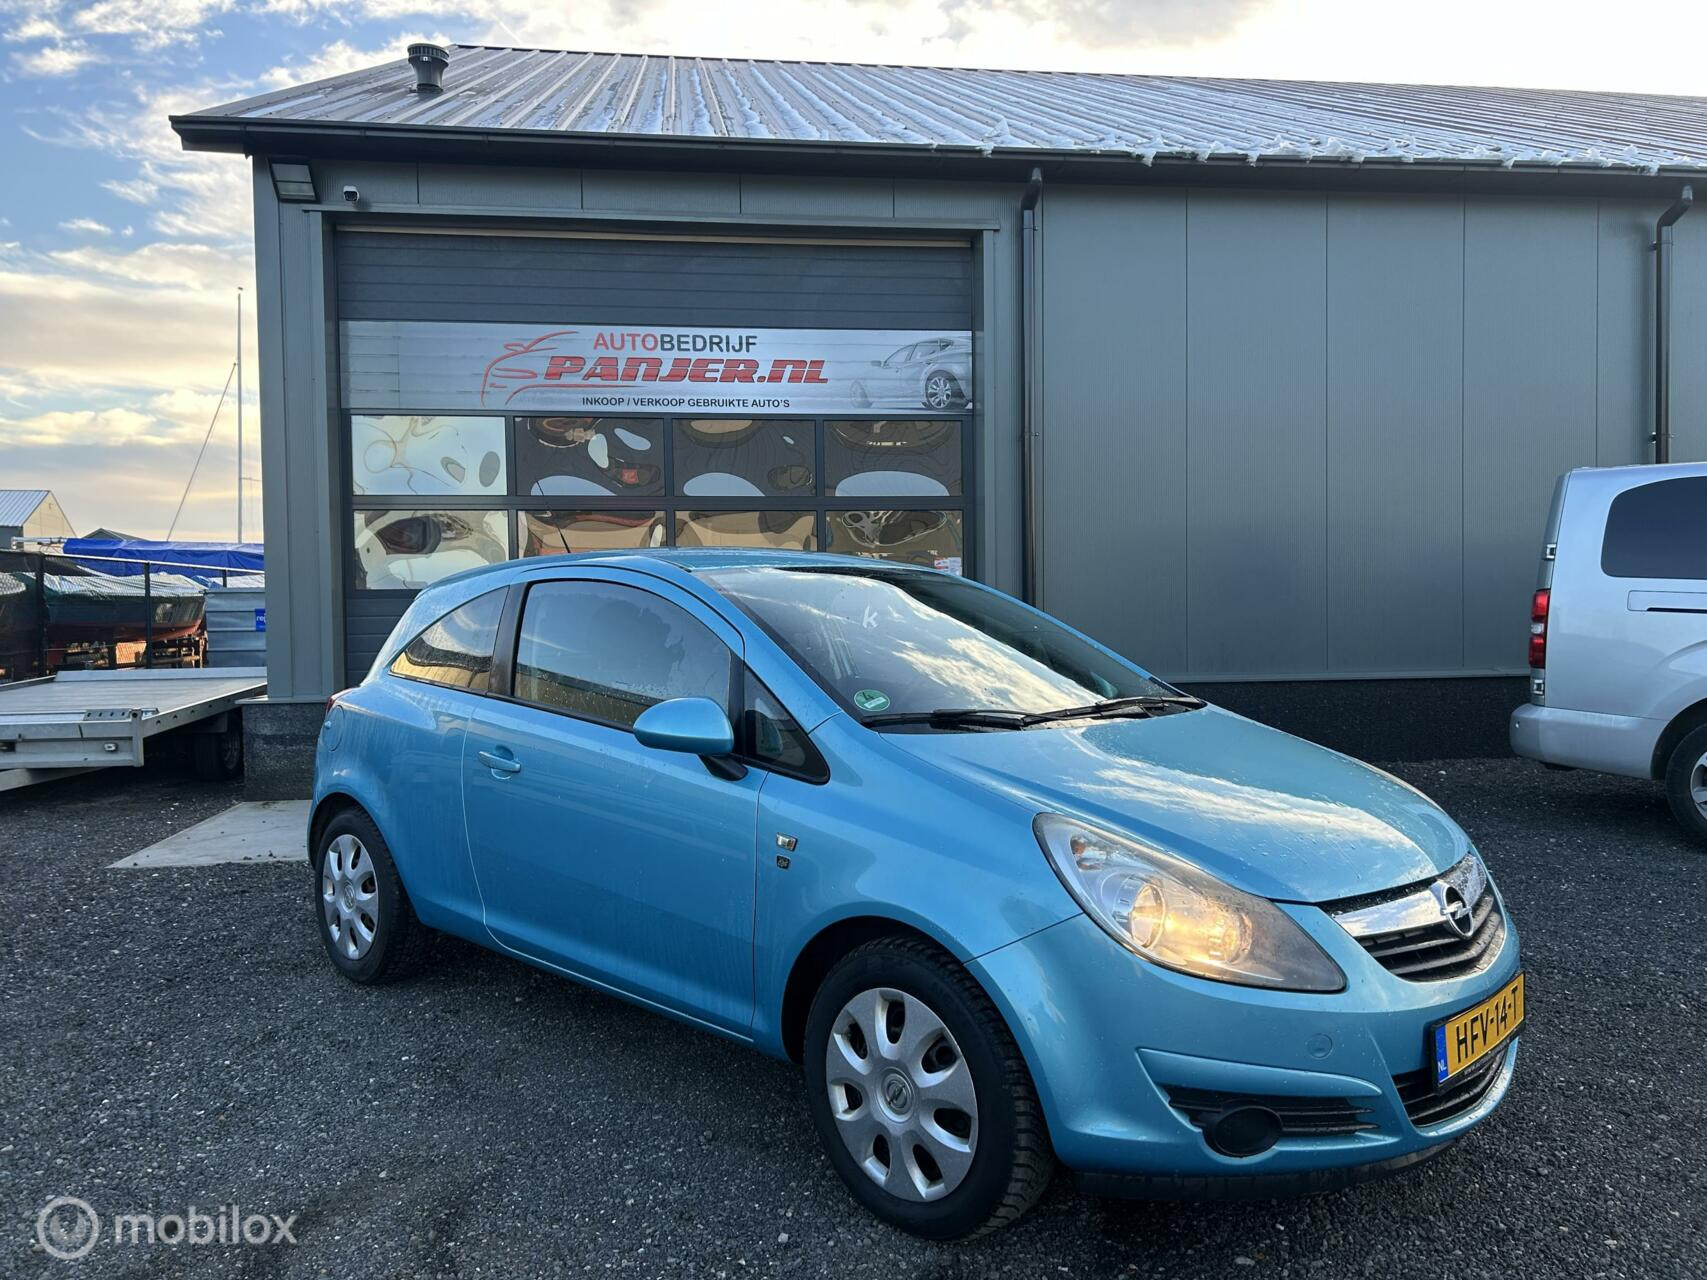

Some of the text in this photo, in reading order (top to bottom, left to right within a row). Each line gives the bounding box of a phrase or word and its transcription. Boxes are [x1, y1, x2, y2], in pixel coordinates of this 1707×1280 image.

[593, 332, 758, 353] AUTOBEDRIJF
[582, 397, 625, 406] INKOOP
[632, 397, 685, 407] VERKOOP
[687, 398, 749, 408] GEBRUIKTE
[751, 399, 790, 408] AUTO'S
[1455, 984, 1518, 1064] HFV-14-T
[1437, 1059, 1447, 1073] NL
